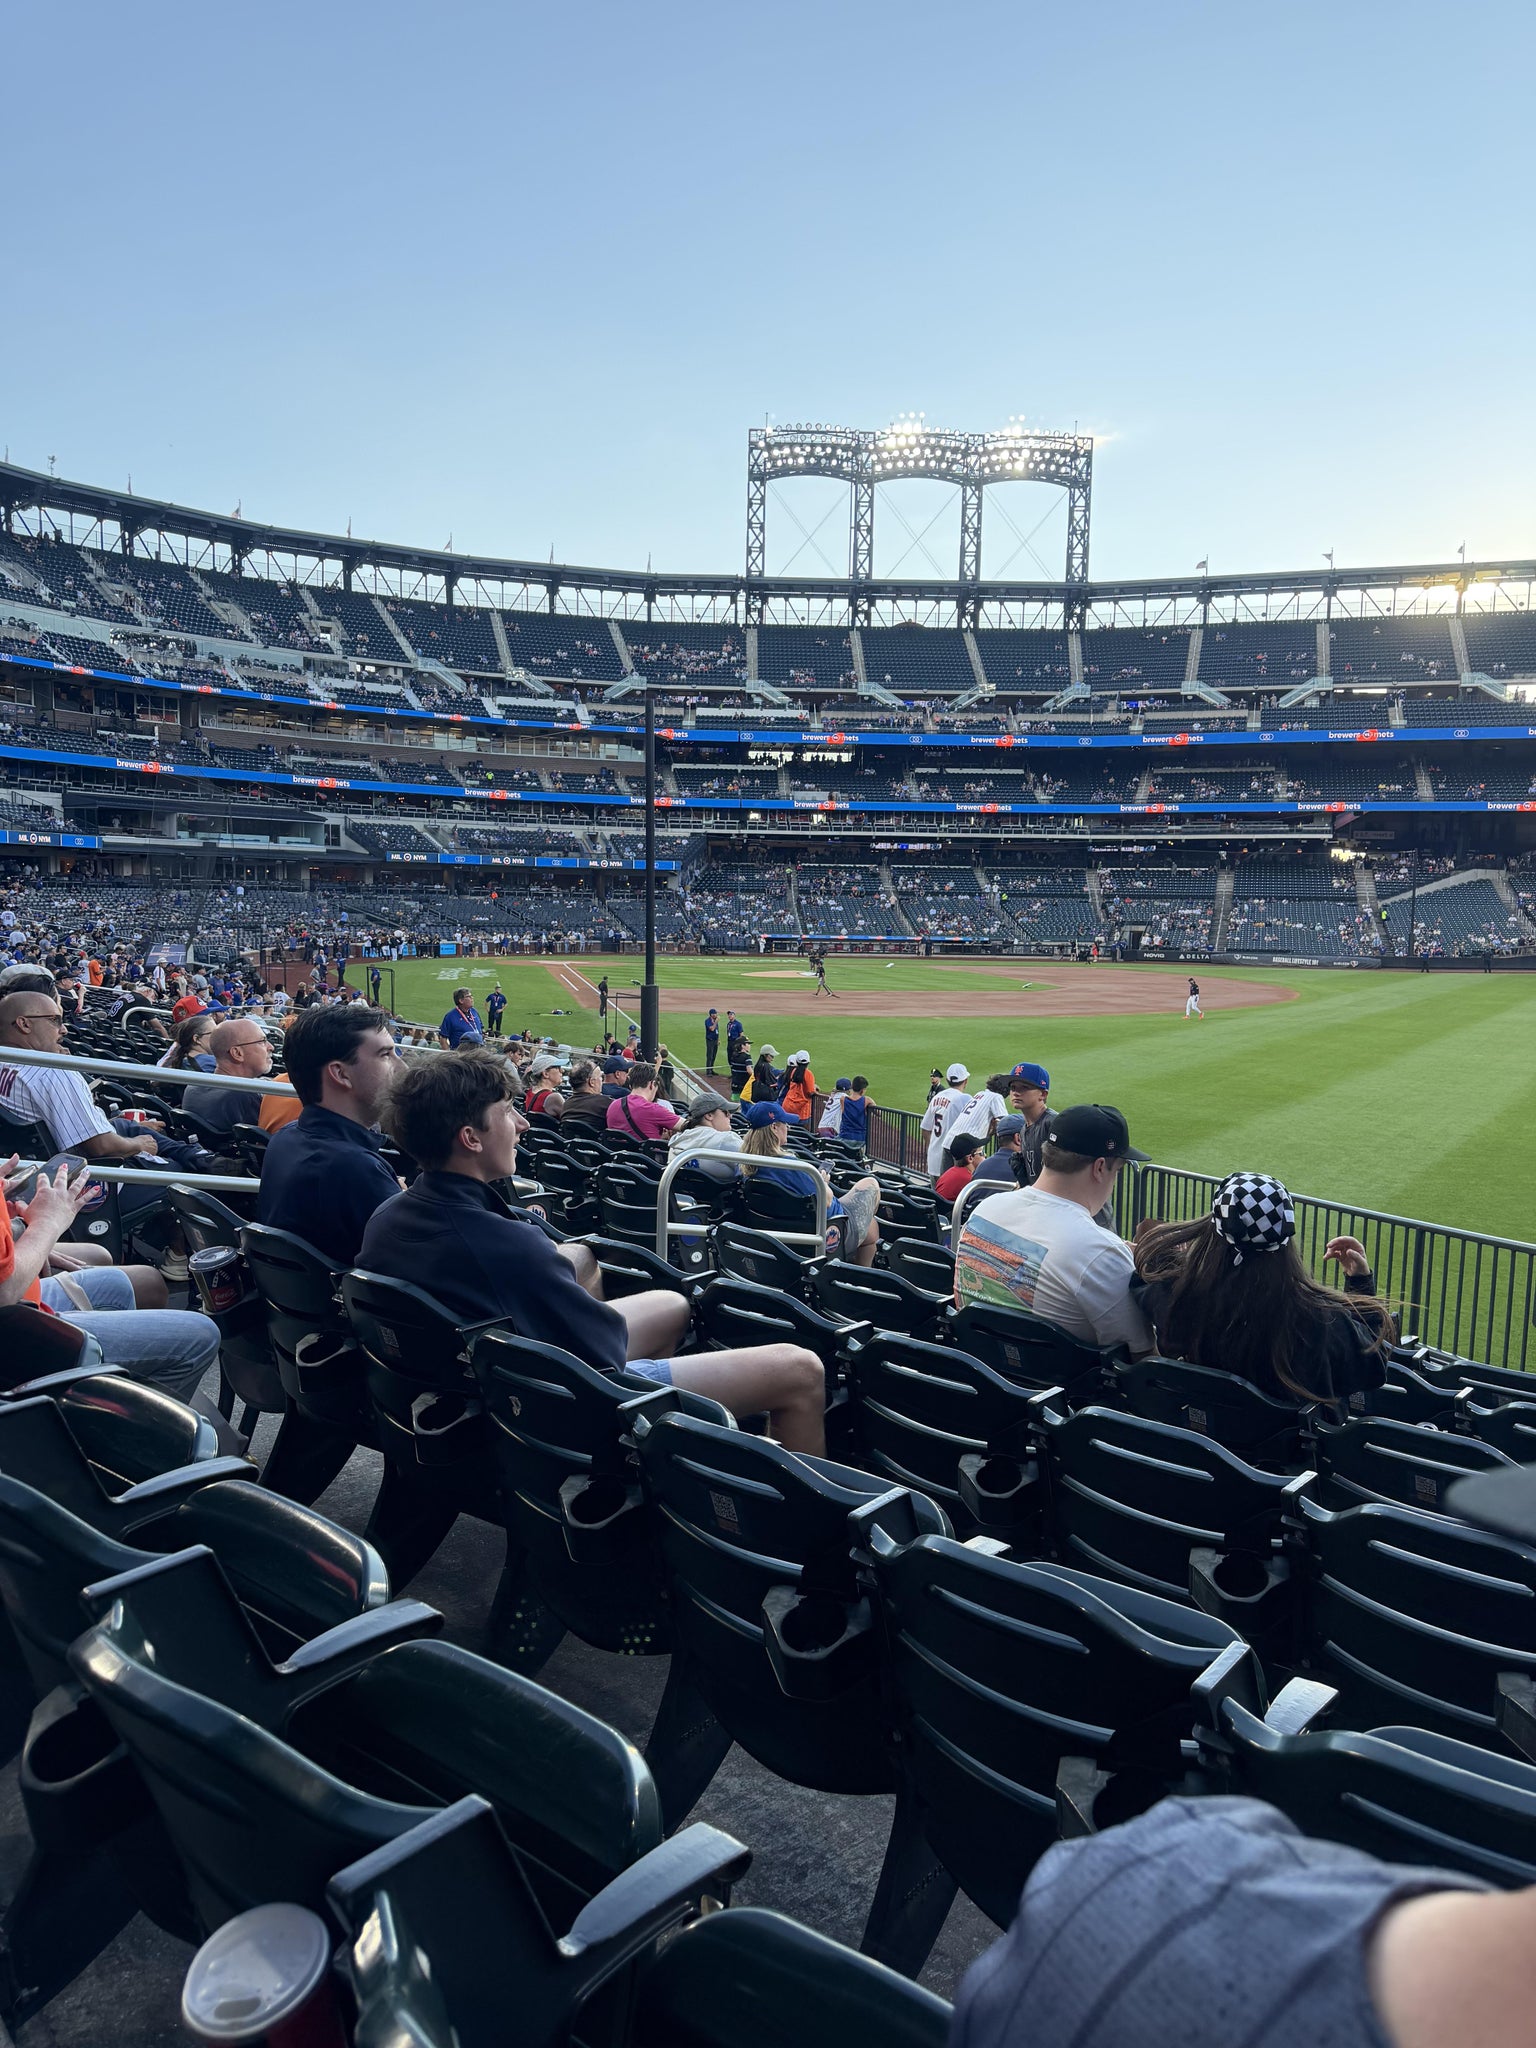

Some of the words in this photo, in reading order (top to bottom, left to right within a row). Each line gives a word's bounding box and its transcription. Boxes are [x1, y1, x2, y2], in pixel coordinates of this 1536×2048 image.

[802, 733, 830, 741] brewers
[1328, 731, 1360, 739] brewers
[117, 758, 145, 769] brewers
[293, 775, 321, 785] brewers
[465, 788, 492, 797] brewers
[832, 801, 849, 809] mets
[956, 803, 984, 811] brewers
[1487, 801, 1519, 809] brewers
[18, 834, 28, 842] MIL
[38, 835, 51, 843] NYM
[933, 1113, 943, 1138] 5
